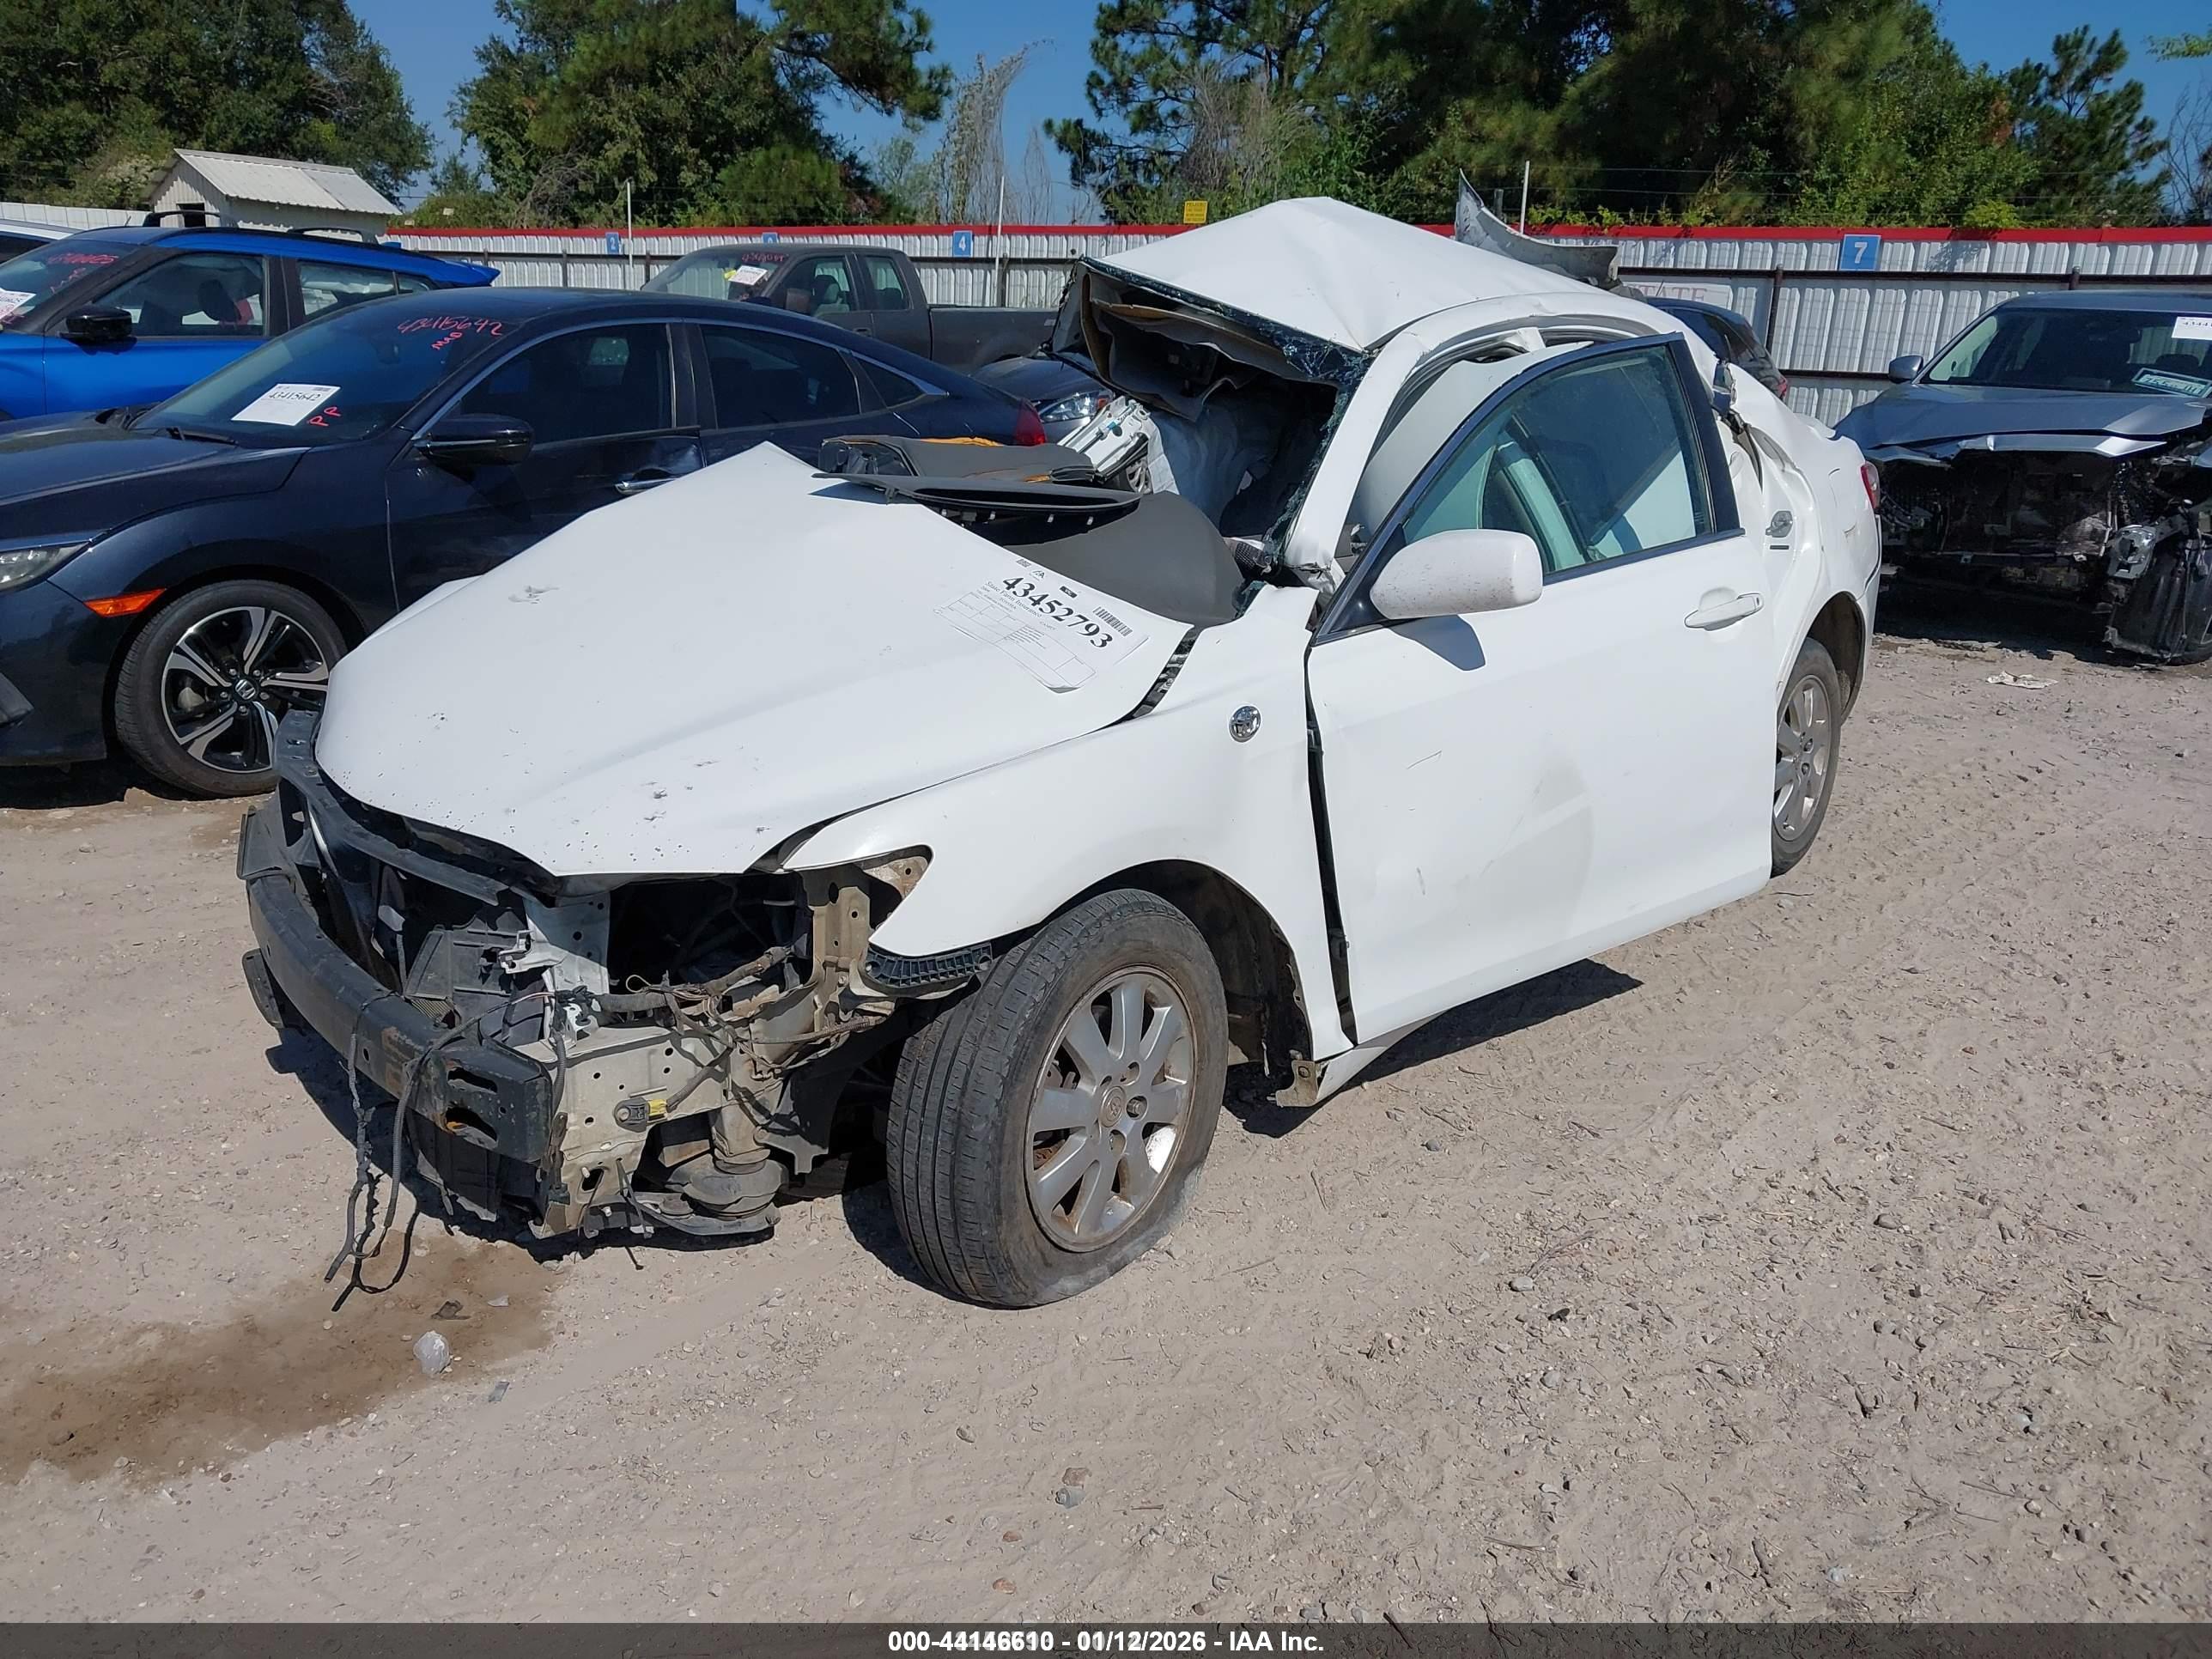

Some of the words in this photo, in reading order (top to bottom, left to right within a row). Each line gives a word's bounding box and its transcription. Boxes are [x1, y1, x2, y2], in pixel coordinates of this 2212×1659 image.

[610, 236, 616, 251] 2
[958, 235, 967, 252] 4
[1854, 241, 1868, 264] 7
[1003, 577, 1113, 648] 43452793
